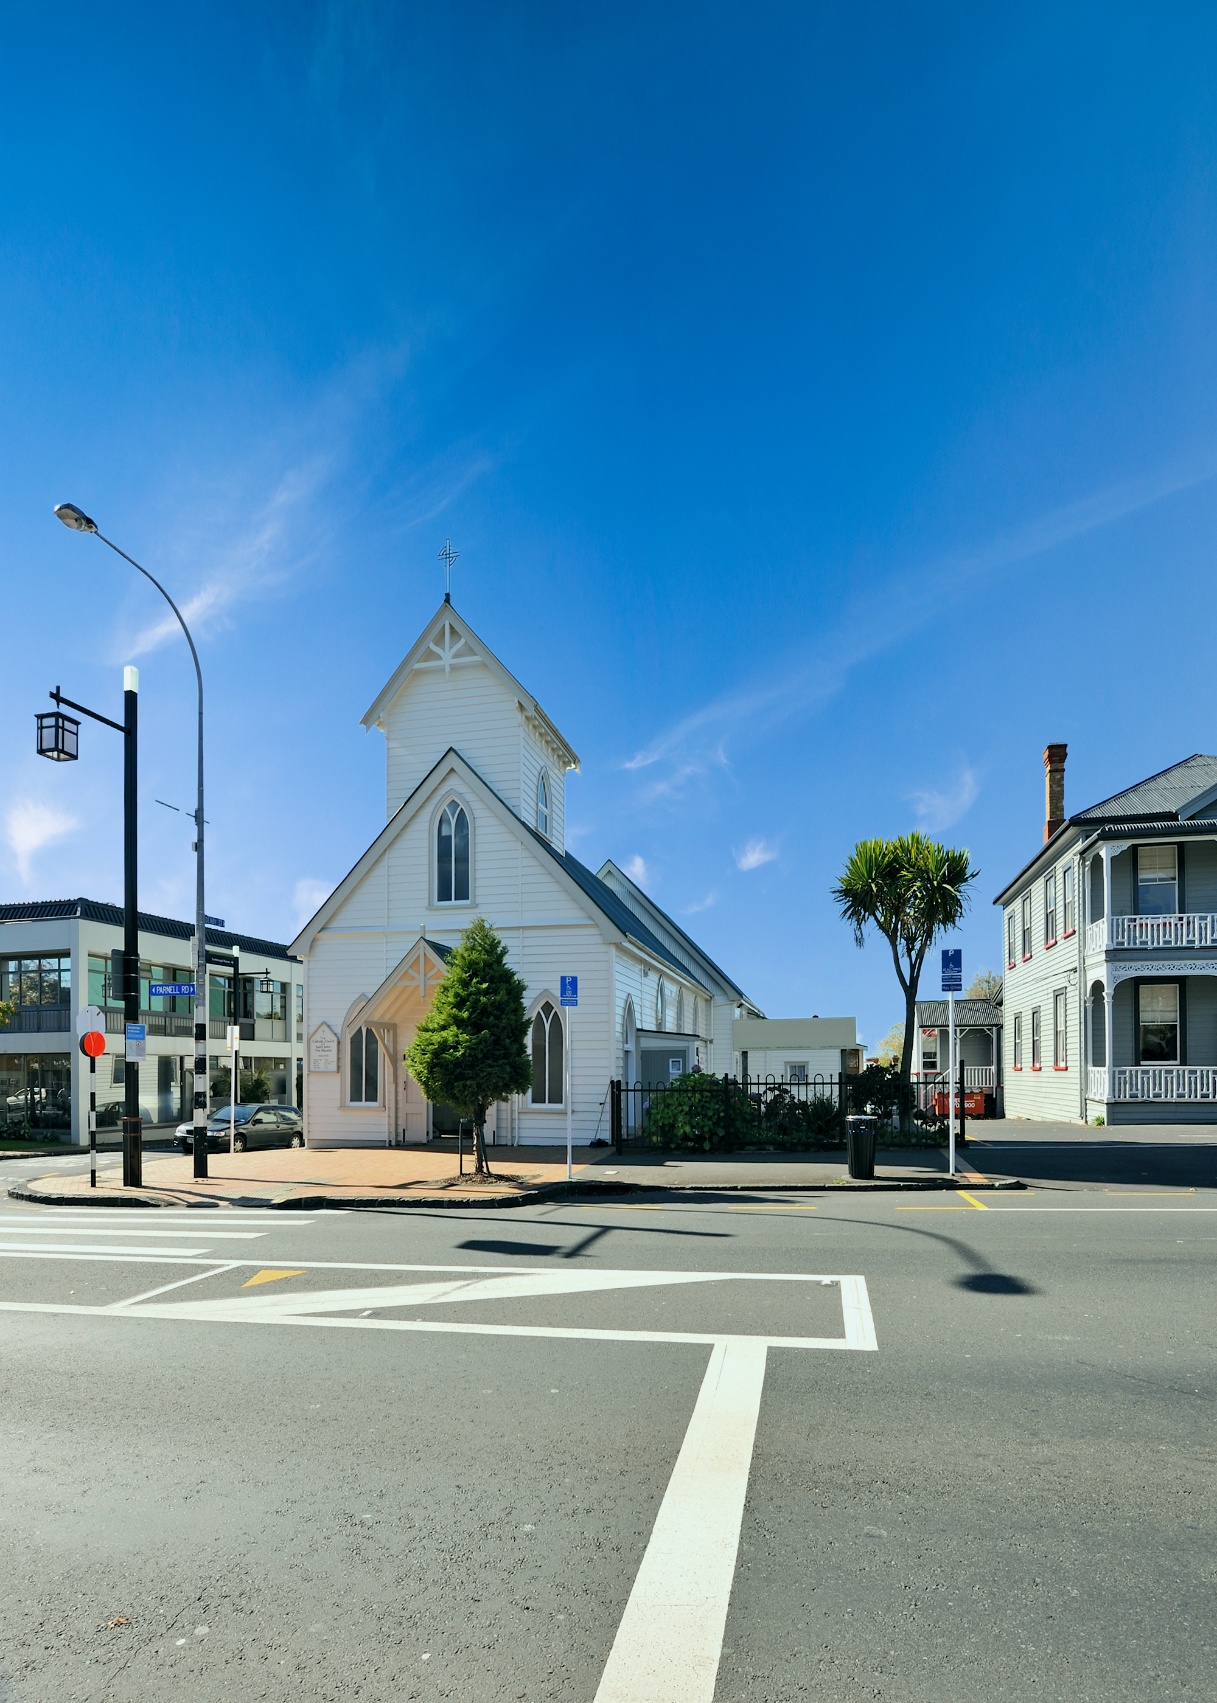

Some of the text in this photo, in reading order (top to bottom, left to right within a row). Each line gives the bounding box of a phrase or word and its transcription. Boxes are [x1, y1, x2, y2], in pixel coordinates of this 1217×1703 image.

[566, 976, 572, 984] P
[156, 985, 189, 994] PARNELL RD
